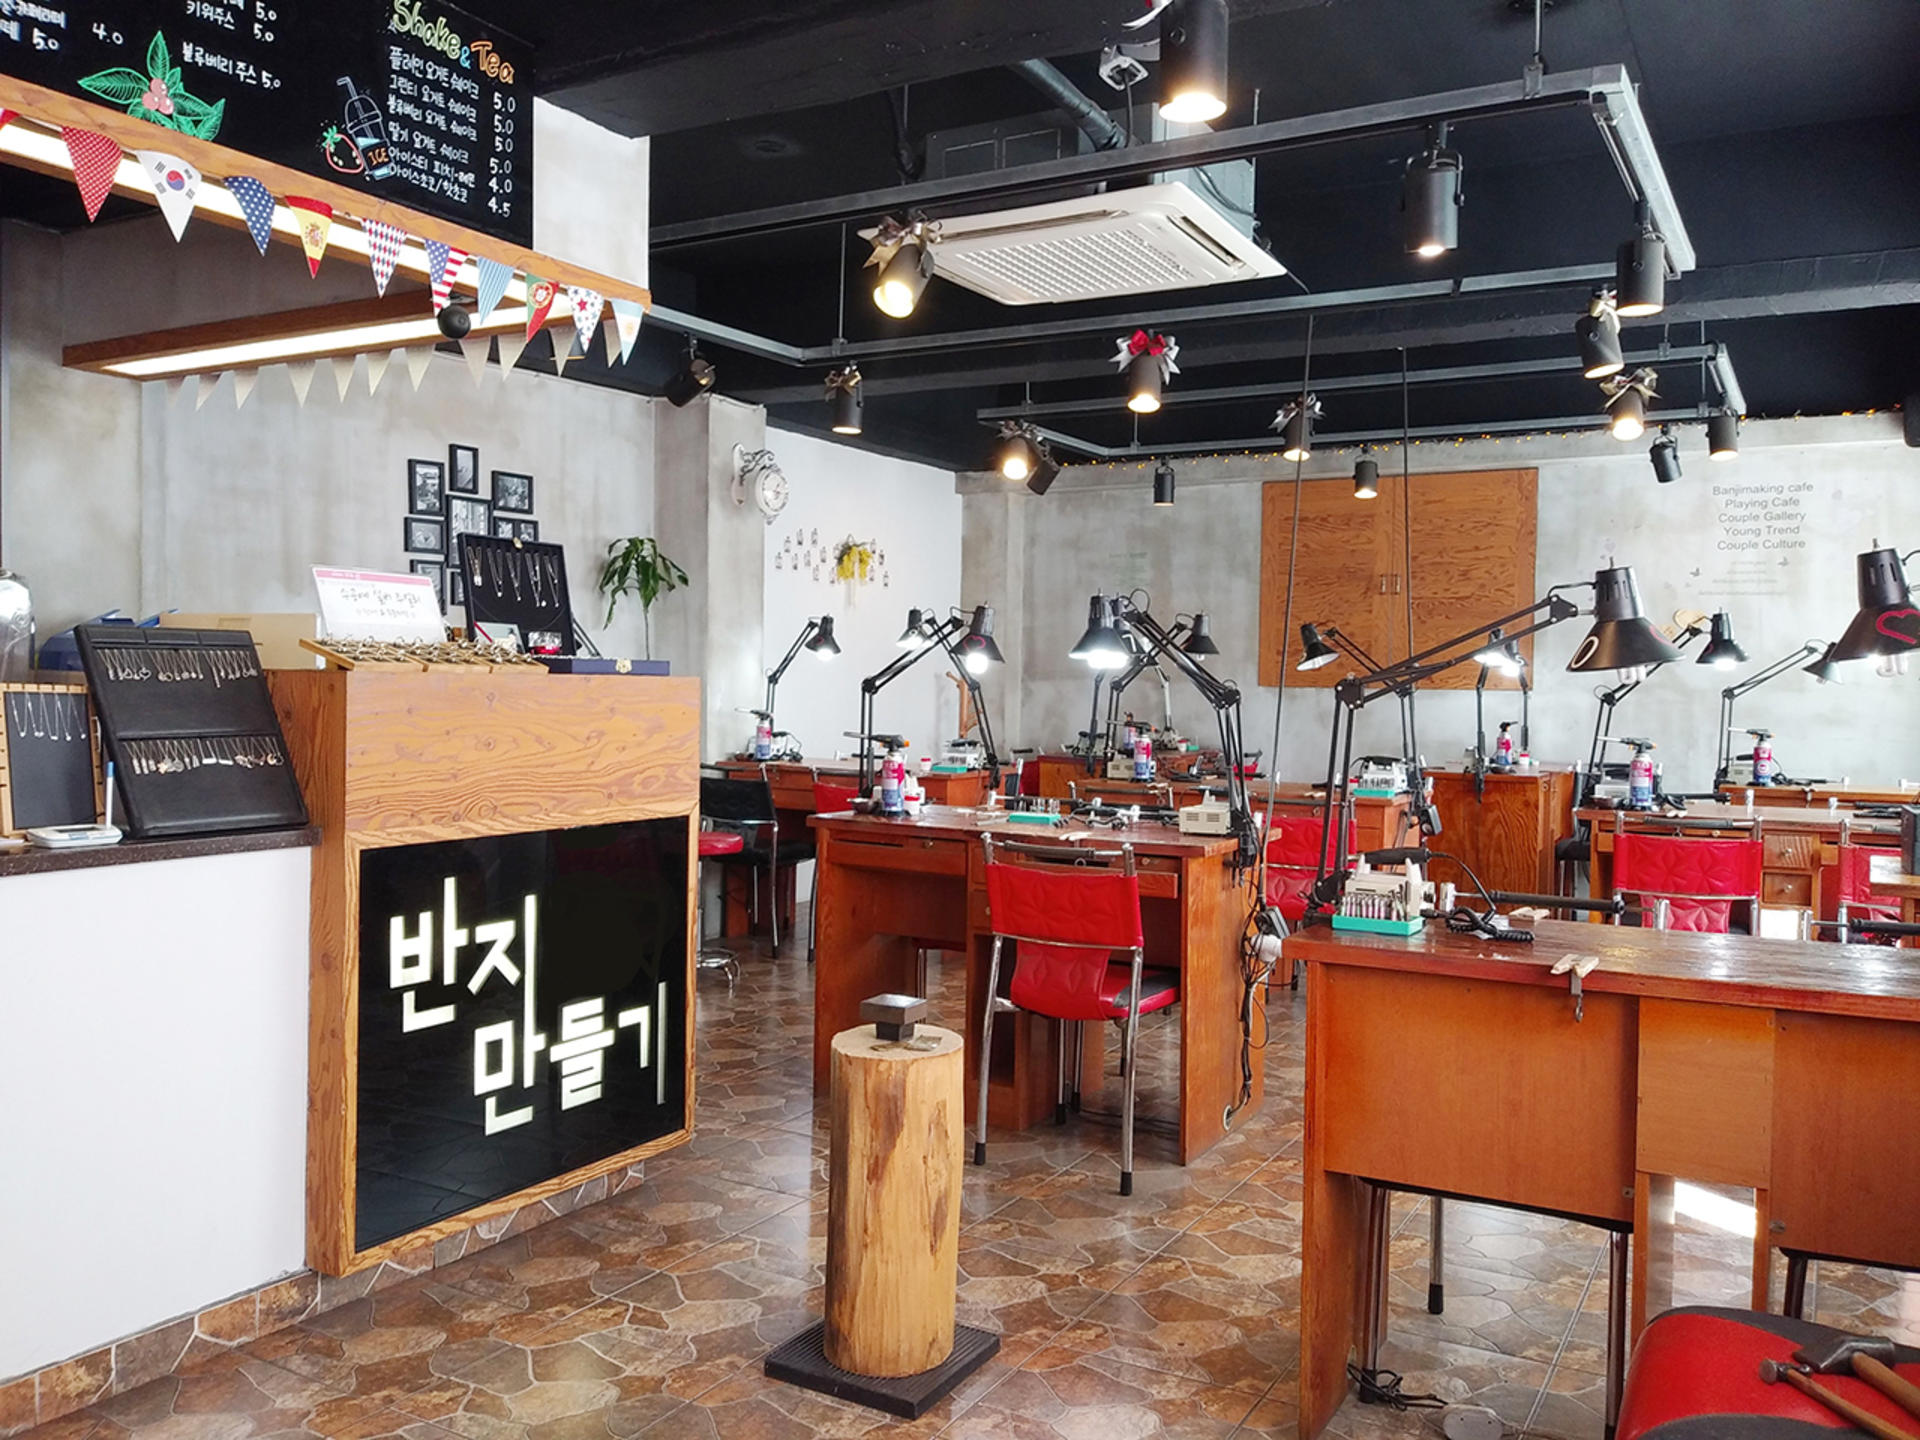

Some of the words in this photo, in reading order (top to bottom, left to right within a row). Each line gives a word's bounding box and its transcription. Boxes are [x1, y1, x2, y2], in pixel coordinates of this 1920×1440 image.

[186, 0, 235, 30] 키위주스
[254, 22, 274, 42] 5.0
[256, 0, 277, 21] 5.0
[32, 27, 59, 50] 5.0
[92, 22, 123, 45] 4.0
[393, 0, 461, 59] Shake
[460, 46, 471, 69] &
[470, 40, 515, 84] Tea
[183, 42, 233, 75] 블루베리
[235, 61, 257, 85] 주스
[262, 70, 281, 89] 5.0
[493, 91, 516, 113] 5.0
[494, 114, 514, 135] 5.0
[489, 157, 512, 174] 5.0
[488, 177, 513, 194] 4.0
[488, 196, 512, 217] 4.5
[1712, 484, 1784, 496] Banjimaking
[1788, 482, 1814, 493] cafe
[1725, 498, 1768, 510] Playing
[1771, 497, 1800, 507] Cafe
[1718, 512, 1760, 524] Couple
[1764, 511, 1806, 522] Gallery
[1723, 526, 1761, 537] Young
[1766, 525, 1800, 535] Trend
[1717, 540, 1759, 551] Couple
[1762, 539, 1806, 549] Culture
[389, 877, 538, 1034] 반지
[474, 982, 667, 1136] 만들기
